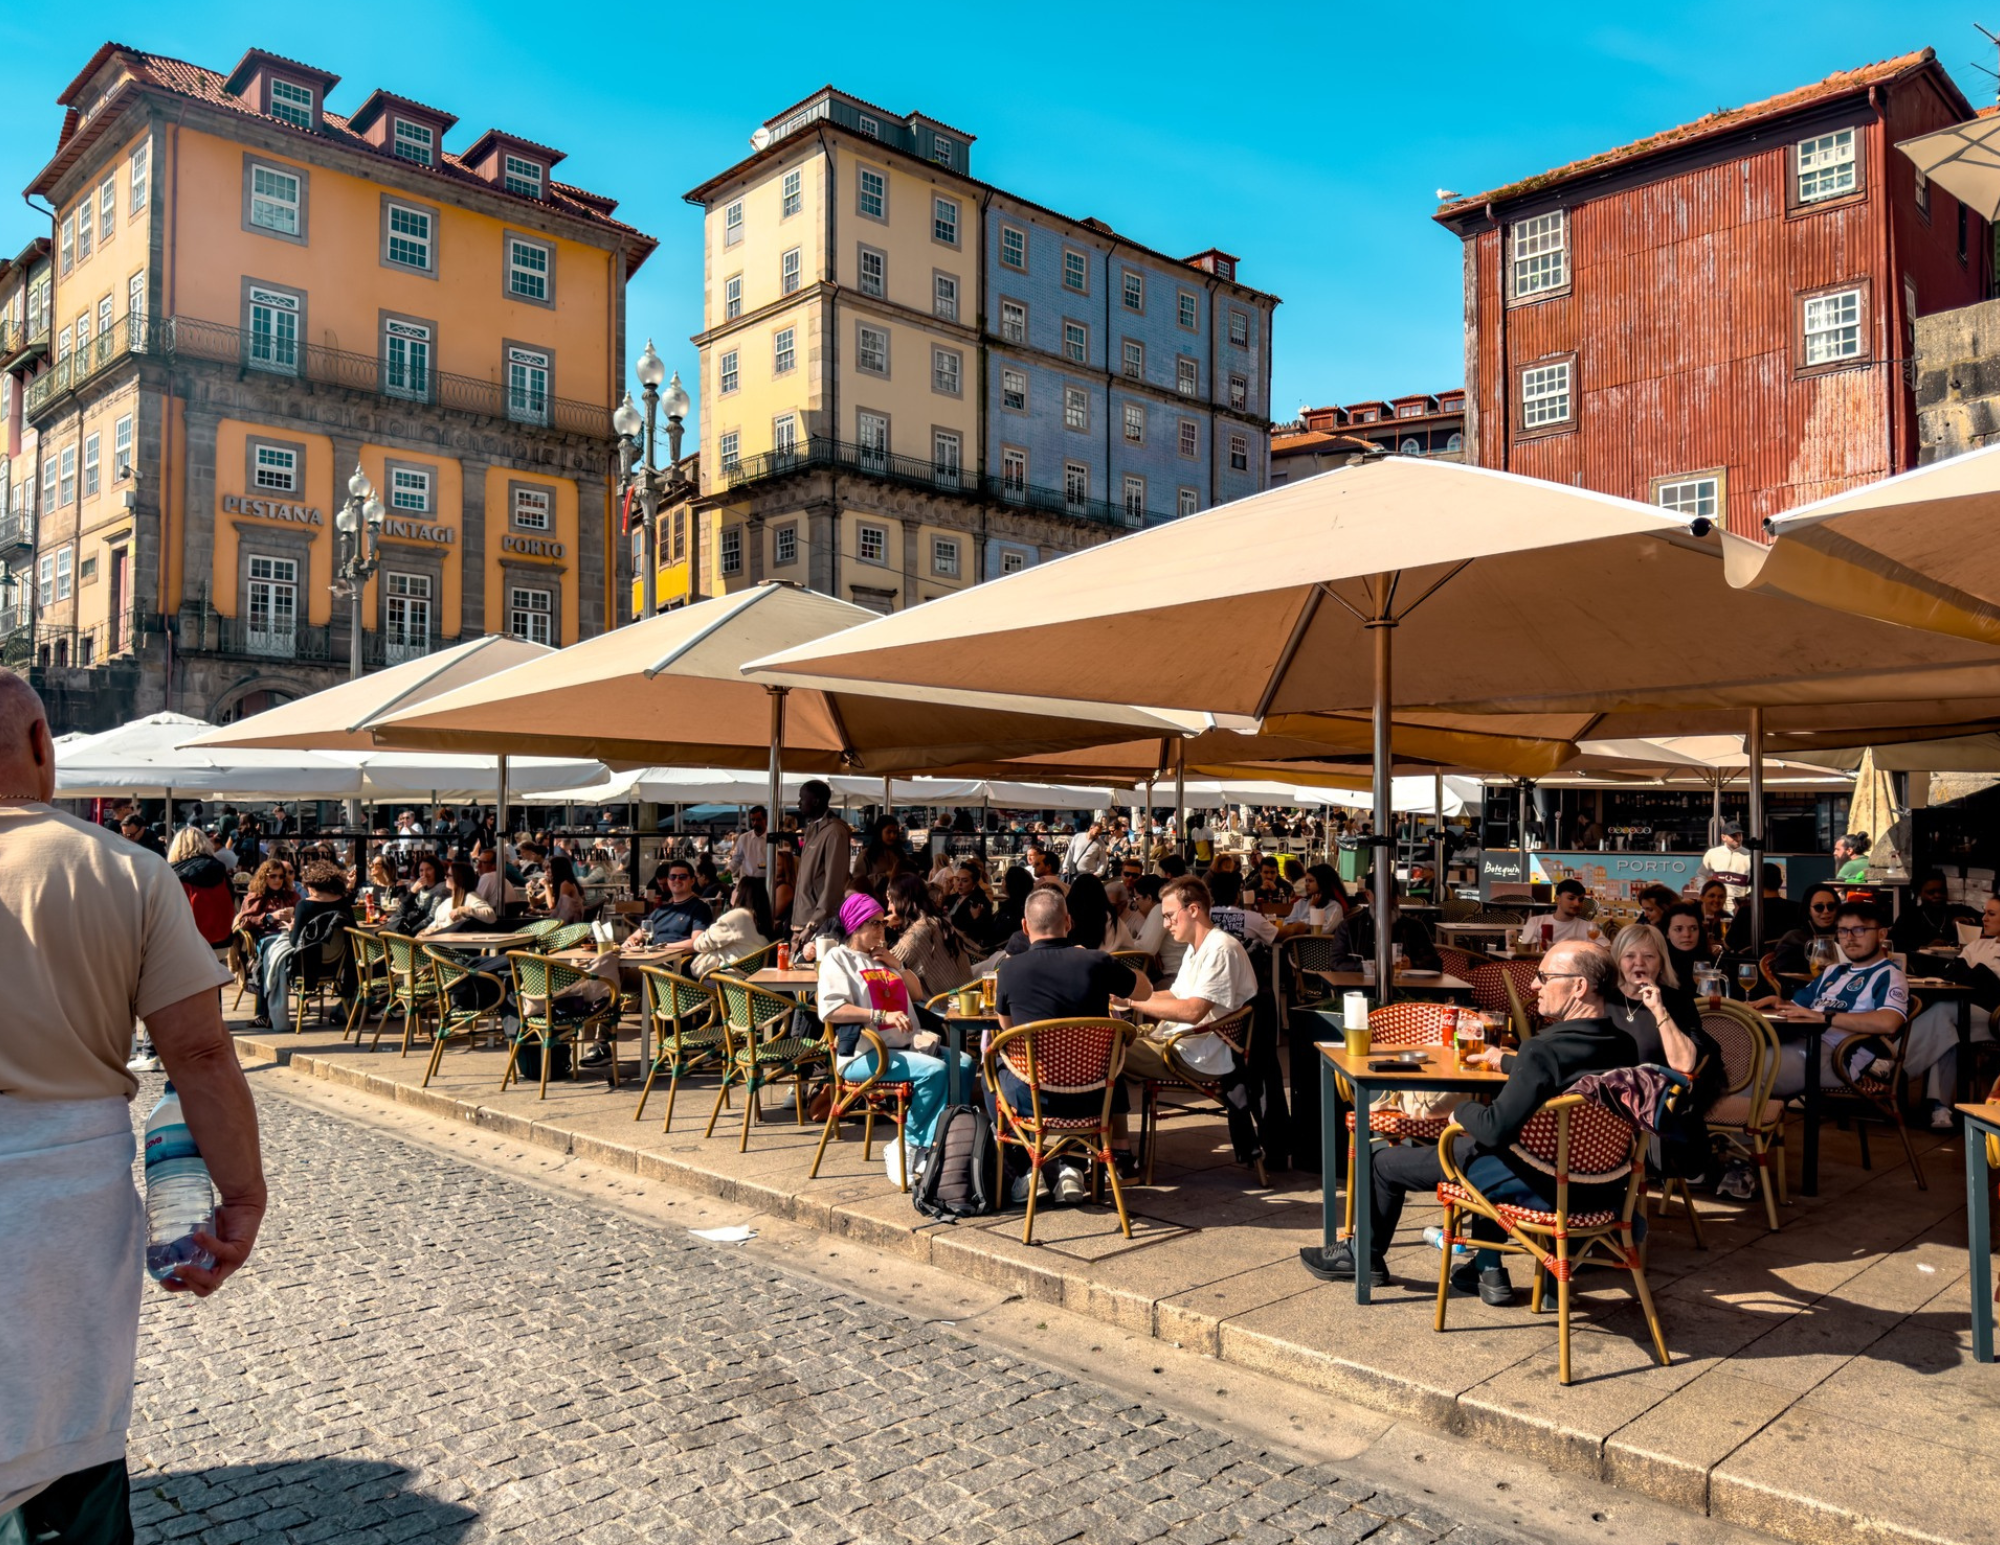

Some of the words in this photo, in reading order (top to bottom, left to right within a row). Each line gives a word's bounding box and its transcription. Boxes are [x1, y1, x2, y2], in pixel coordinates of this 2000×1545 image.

[223, 495, 324, 526] PESTANA
[503, 535, 567, 559] PORTO
[570, 848, 617, 862] TAVERNA
[1617, 860, 1687, 873] PORTO
